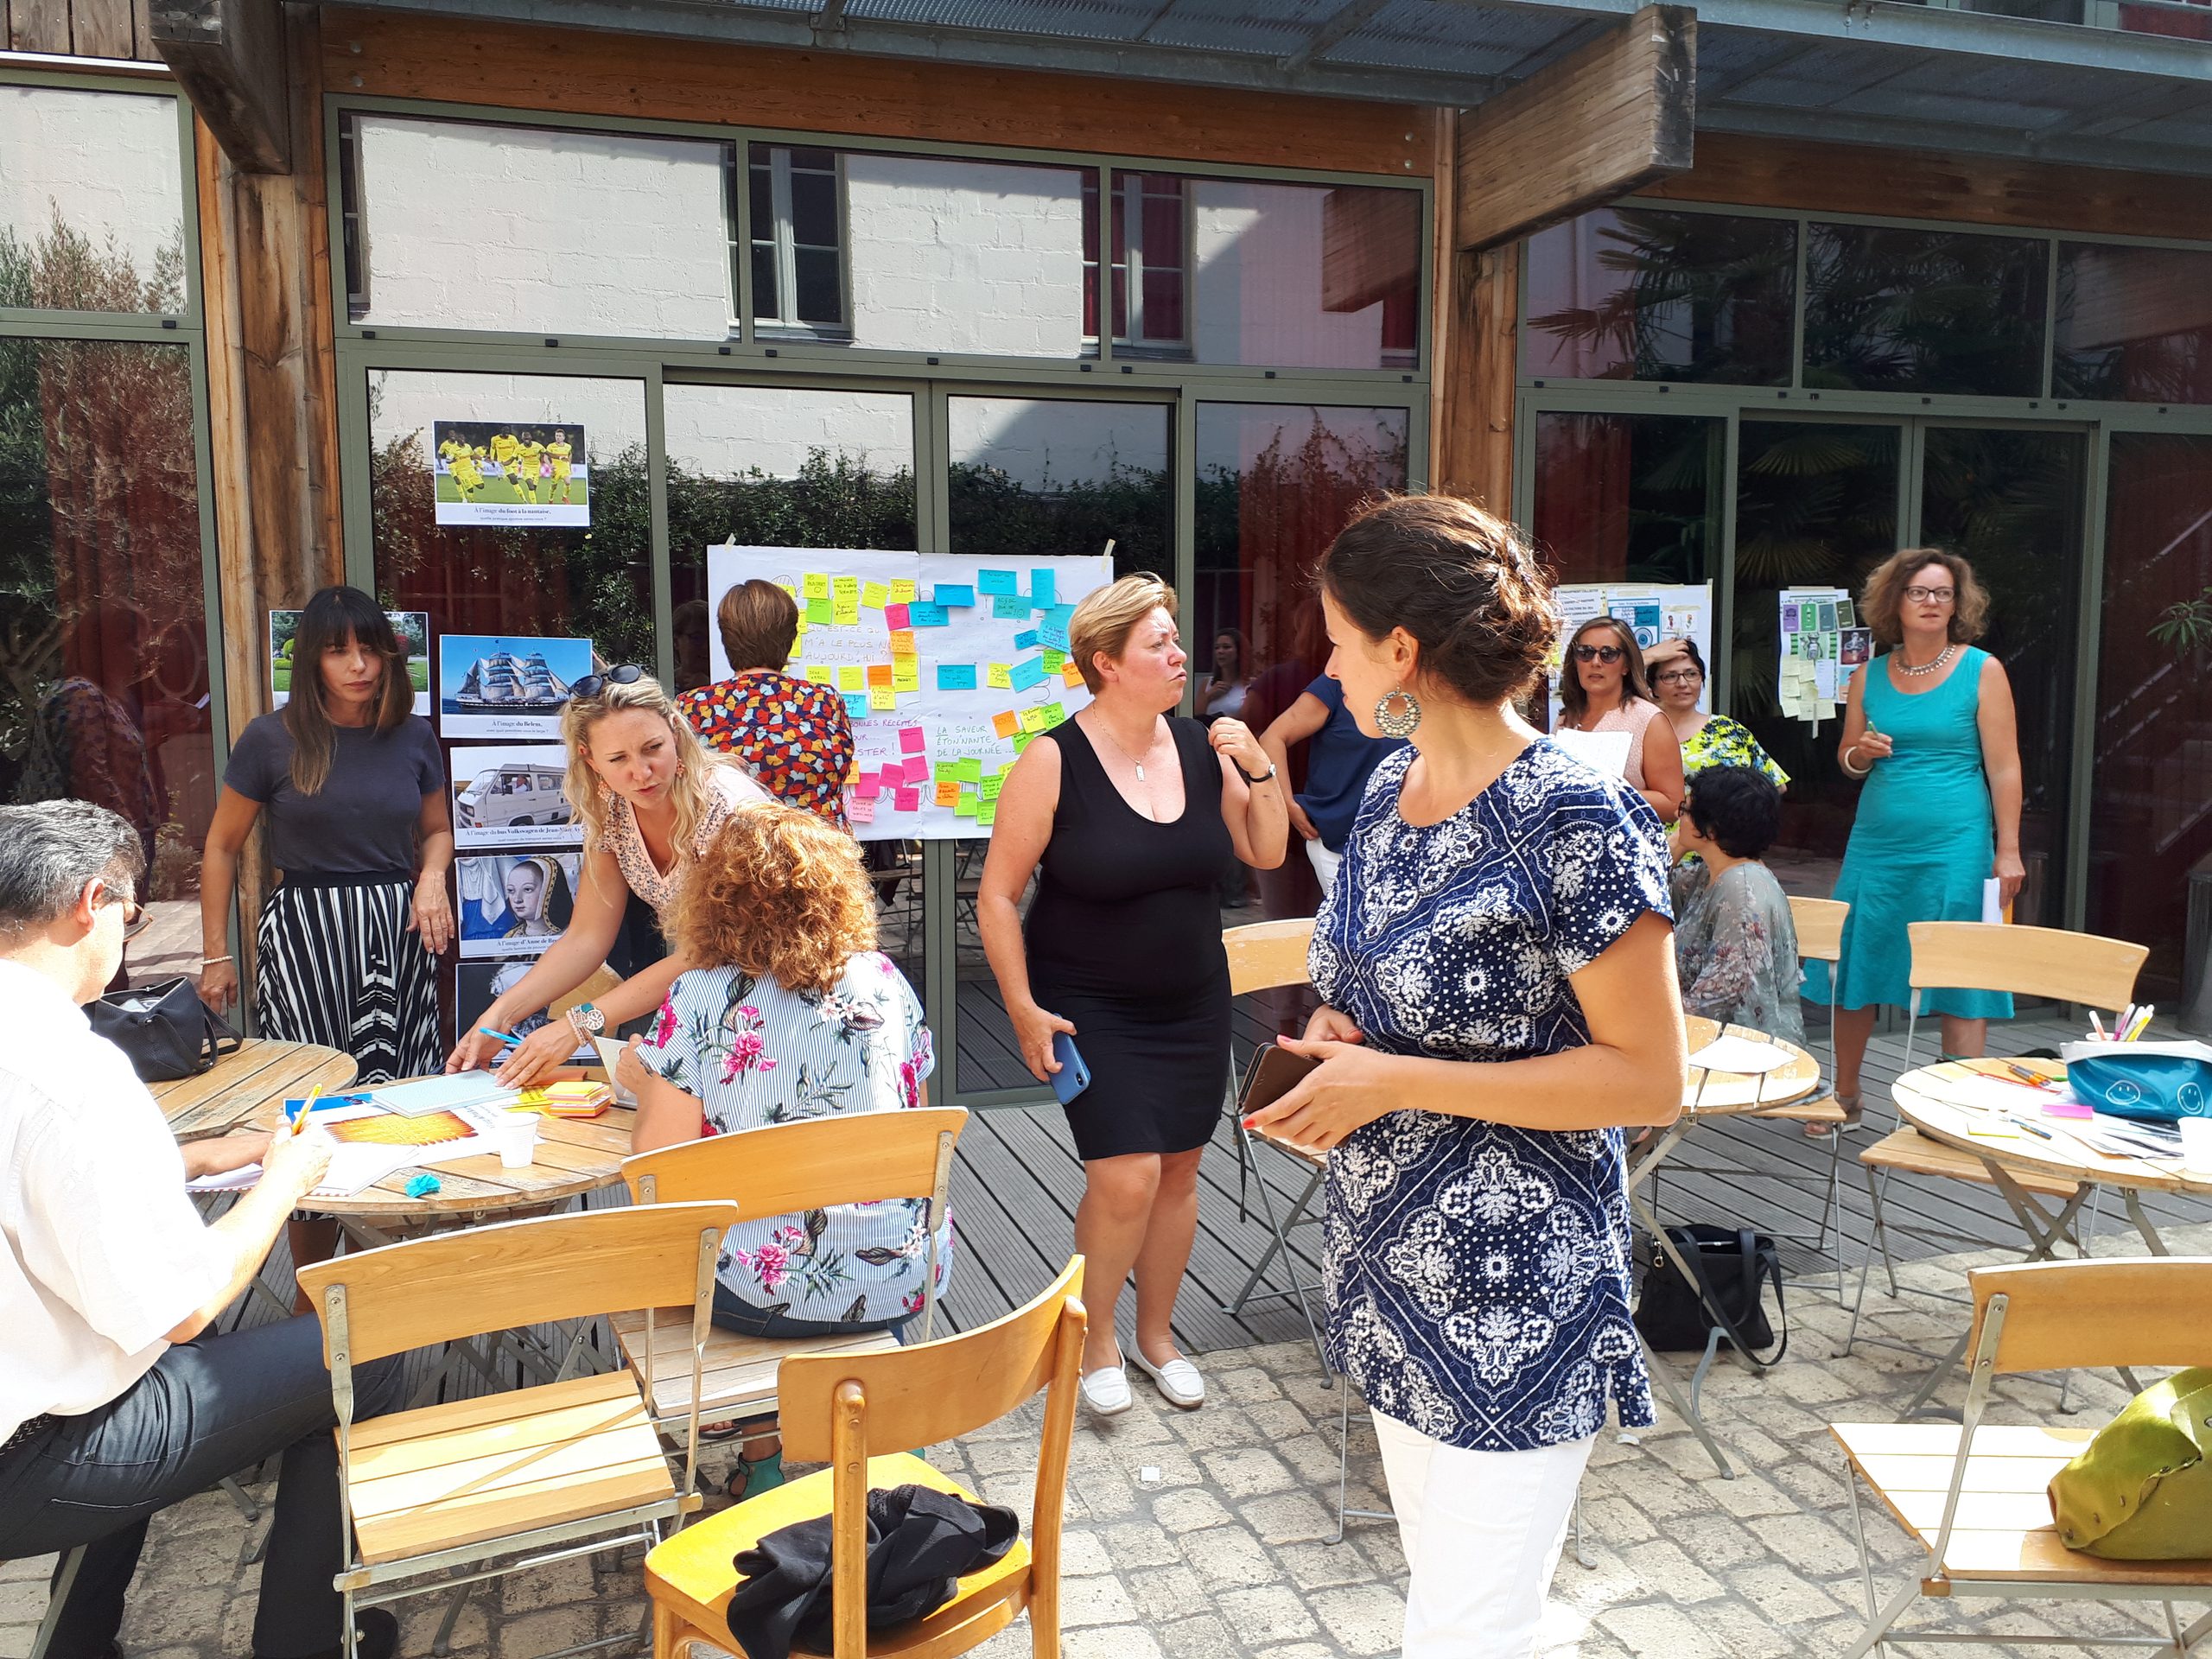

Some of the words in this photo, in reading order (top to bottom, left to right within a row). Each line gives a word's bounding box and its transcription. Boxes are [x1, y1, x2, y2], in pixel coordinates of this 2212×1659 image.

[857, 747, 888, 756] STER
[937, 748, 948, 757] DE
[963, 742, 1001, 755] JOURNÉE
